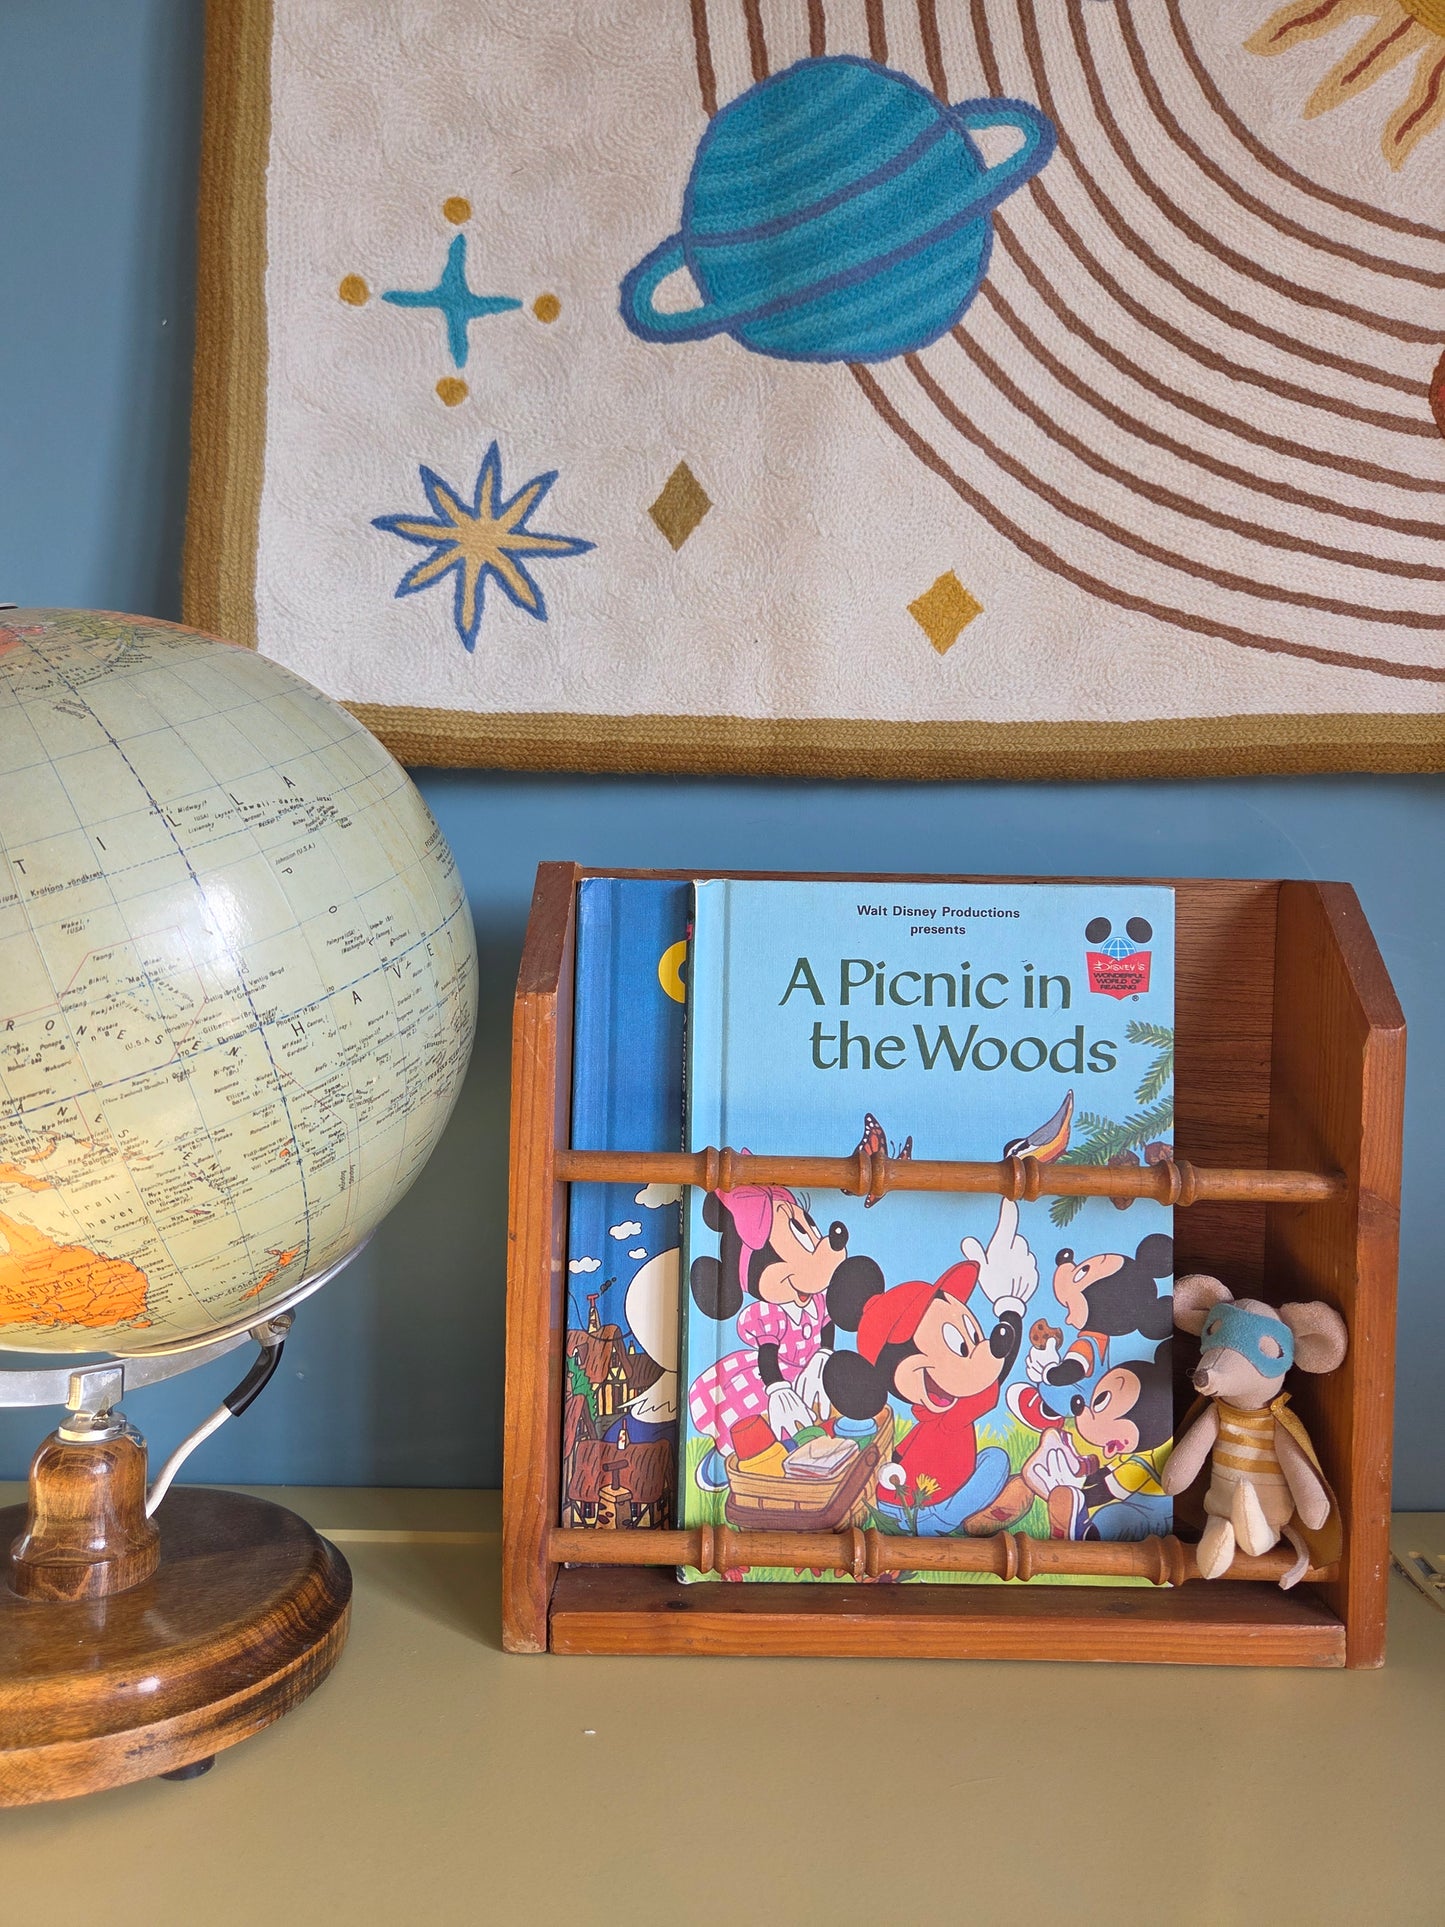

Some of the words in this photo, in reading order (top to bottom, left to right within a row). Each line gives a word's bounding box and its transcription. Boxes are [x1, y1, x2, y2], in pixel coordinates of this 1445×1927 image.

[857, 905, 887, 917] Walt
[892, 905, 937, 920] Disney
[942, 906, 1021, 919] Productions
[910, 924, 966, 937] presents
[778, 957, 826, 1006] A
[839, 958, 1010, 1010] Picnic
[1023, 963, 1071, 1010] in
[809, 1020, 907, 1071] the
[913, 1024, 1118, 1074] Woods
